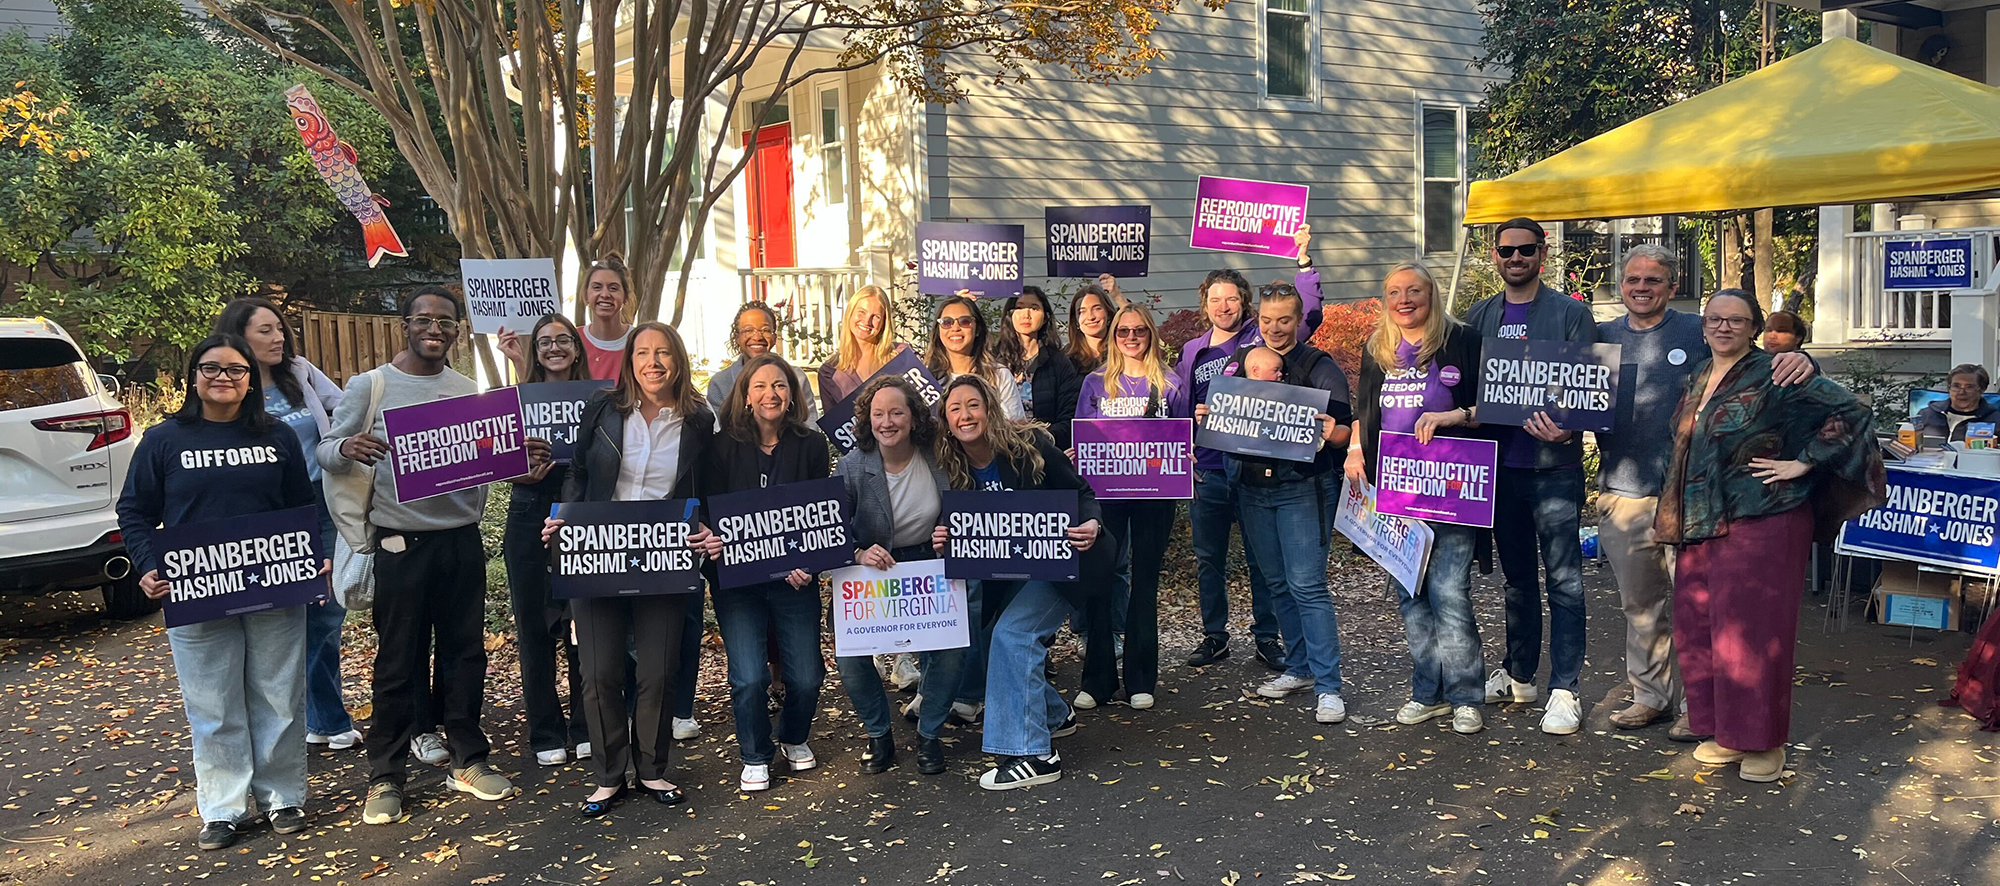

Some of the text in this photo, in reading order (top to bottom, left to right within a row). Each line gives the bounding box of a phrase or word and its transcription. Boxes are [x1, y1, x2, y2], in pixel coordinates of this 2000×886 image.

[1200, 197, 1301, 222] REPRODUCTIVE
[1050, 223, 1145, 244] SPANBERGER
[1198, 212, 1296, 237] FREEDOM FOR ALL
[922, 239, 1018, 263] SPANBERGER
[1051, 245, 1145, 261] HASHMI JONES
[1890, 249, 1965, 265] SPANBERGER
[922, 261, 1018, 280] HASHMI JONES
[1890, 264, 1965, 278] HASHMI JONES
[467, 277, 552, 298] SPANBERGER
[471, 300, 555, 317] HASHMI JONES
[1381, 382, 1427, 392] REEDOM
[1486, 358, 1610, 390] SPANBERGER
[1101, 396, 1168, 409] REPRODUCE
[1210, 392, 1319, 426] SPANBERGER
[1484, 383, 1609, 411] HASHMI JONES
[394, 413, 518, 455] REPRODUCTIVE
[1205, 414, 1315, 444] HASHMI JONES
[180, 446, 278, 469] GIFFORDS
[397, 442, 479, 475] FREEDOM
[477, 437, 493, 450] FOR
[492, 432, 521, 456] ALL
[1077, 442, 1186, 459] REPRODUCTIVE
[70, 461, 108, 472] RDX
[1078, 459, 1187, 475] FREEDOM FOR ALL
[1382, 455, 1489, 484] REPRODUCTIVE
[1381, 473, 1488, 502] FREEDOM FOR ALL
[1885, 484, 1998, 523] ANBERGER
[718, 499, 843, 543] SPANBERGER
[949, 511, 1071, 537] SPANBERGER
[1346, 497, 1367, 520] FOR
[1369, 512, 1417, 567] VIRGINIA
[1859, 509, 1994, 547] HASHMI JONES
[559, 522, 691, 552] SPANBERGER
[723, 526, 847, 566] HASHMI JONES
[951, 539, 1072, 559] HASHMI JONES
[1350, 519, 1377, 544] GOVERNOR
[1377, 541, 1389, 552] FOR
[1388, 549, 1413, 576] EVERYONE
[164, 531, 313, 578] SPANBERGER
[560, 550, 693, 575] HASHMI JONES
[169, 558, 318, 603] HASHMI JONES
[842, 574, 958, 600] SPANBERGER
[844, 594, 958, 621] FOR VIRGINIA
[846, 619, 958, 635] A GOVERNOR FOR EVERYONE
